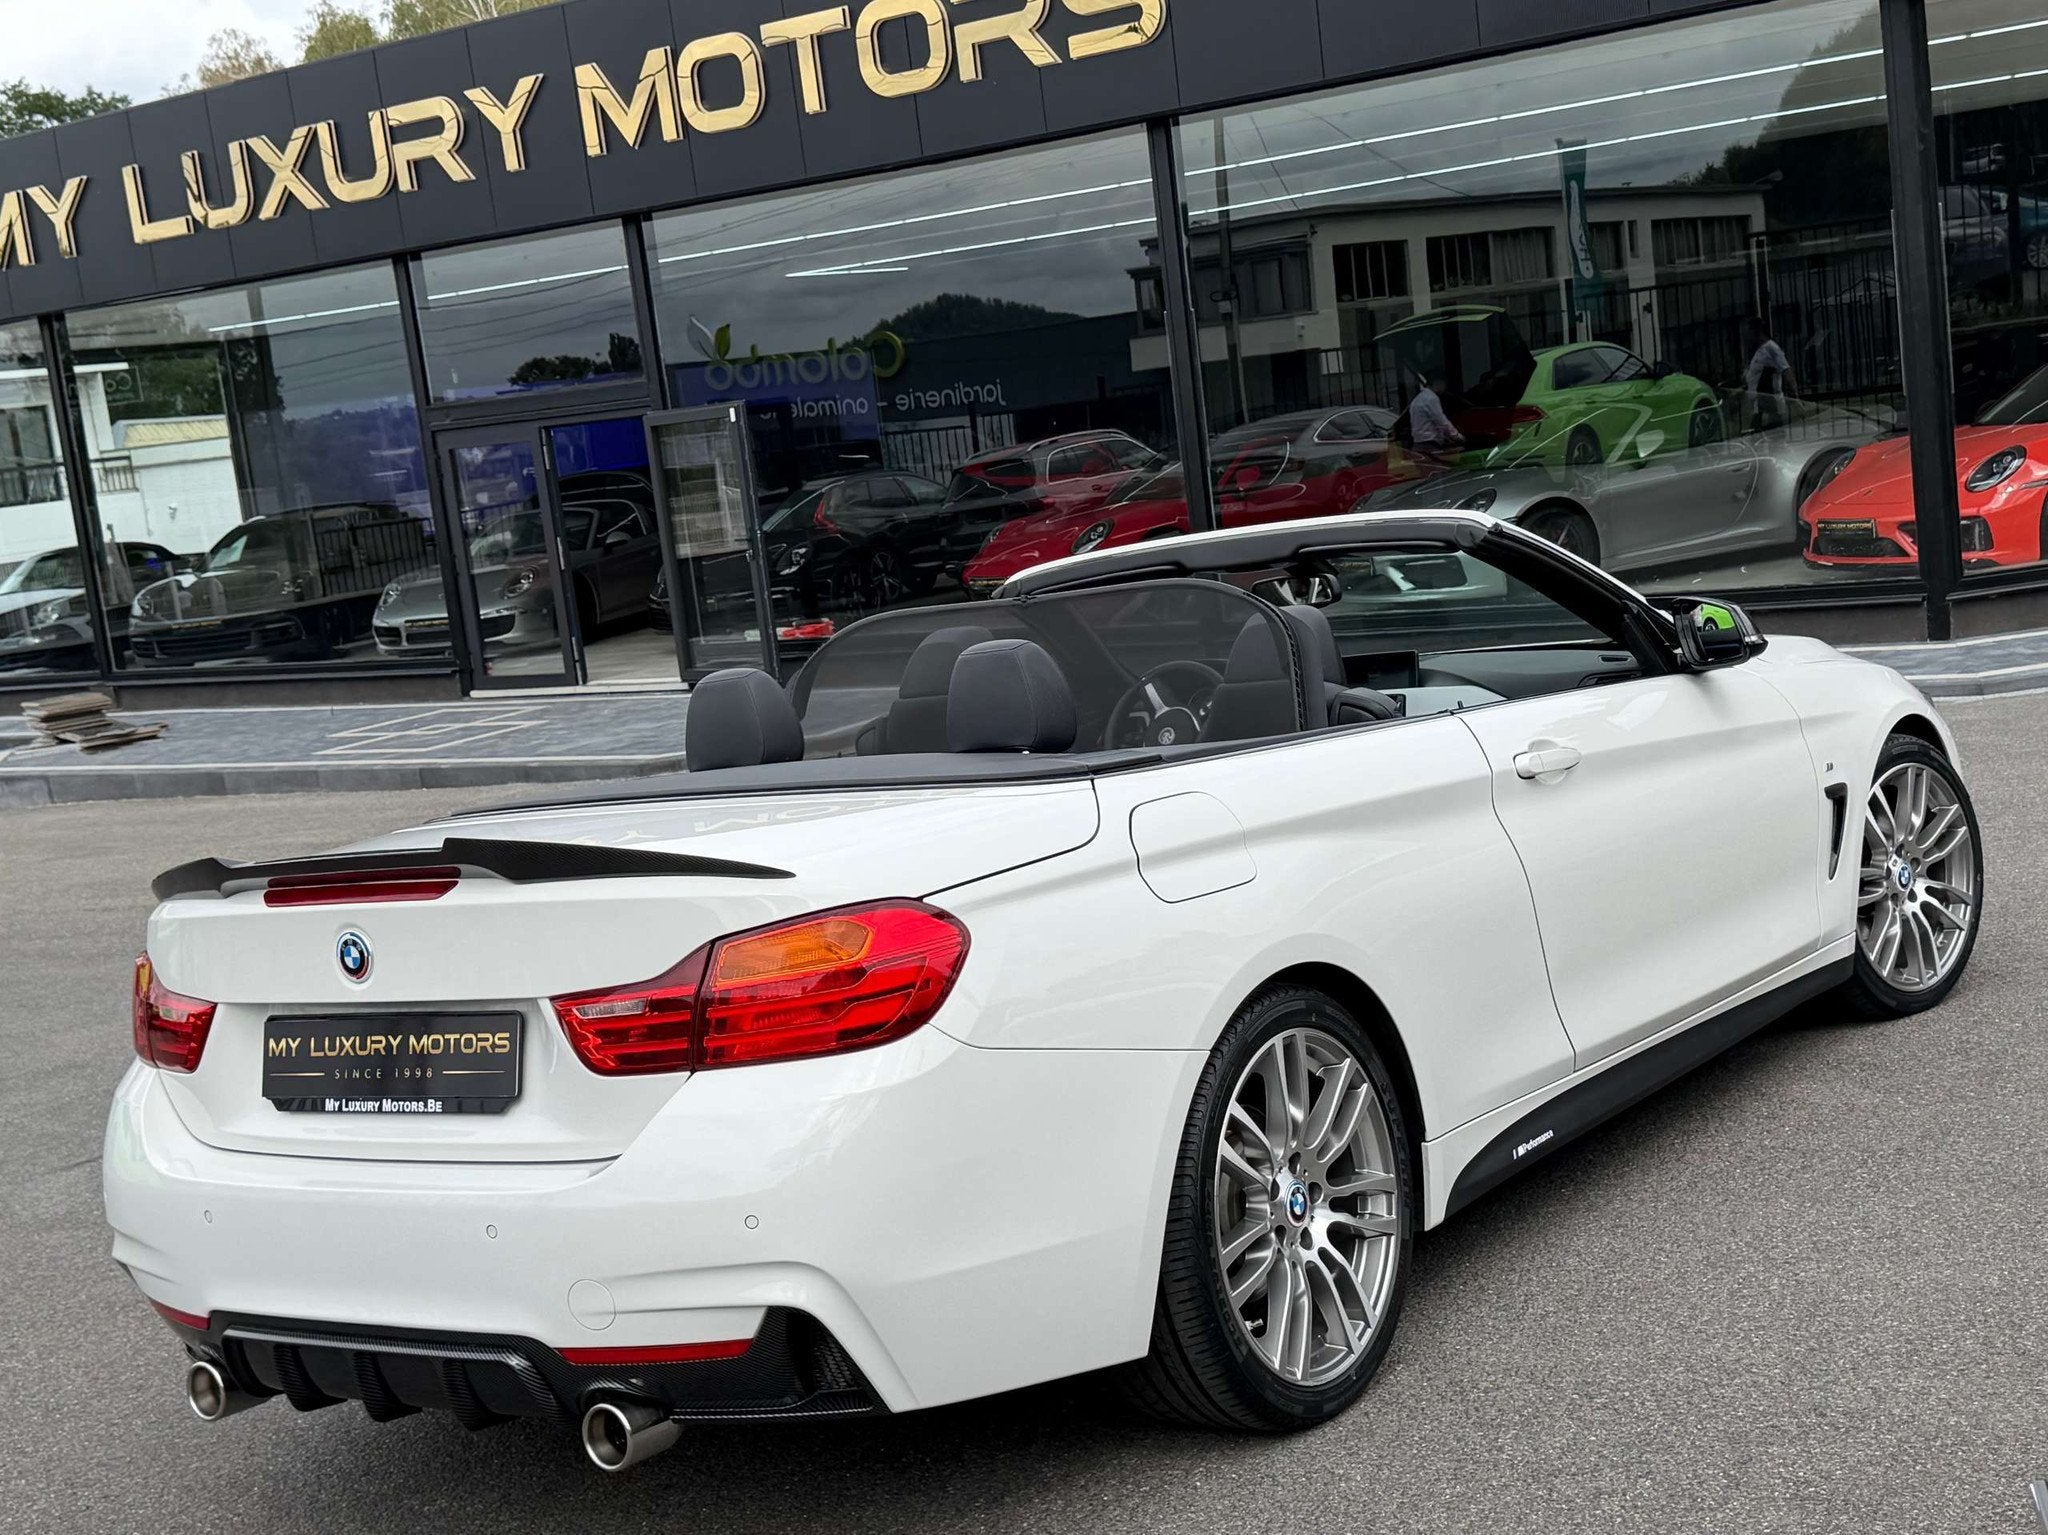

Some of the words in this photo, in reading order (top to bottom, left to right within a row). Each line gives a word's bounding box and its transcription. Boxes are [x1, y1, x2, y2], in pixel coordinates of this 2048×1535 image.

[122, 73, 544, 245] LUXURY
[268, 1037, 301, 1057] MY
[310, 1035, 403, 1057] LUXURY
[408, 1032, 511, 1056] MOTORS
[334, 1068, 383, 1080] SINCE
[394, 1067, 434, 1079] 1998
